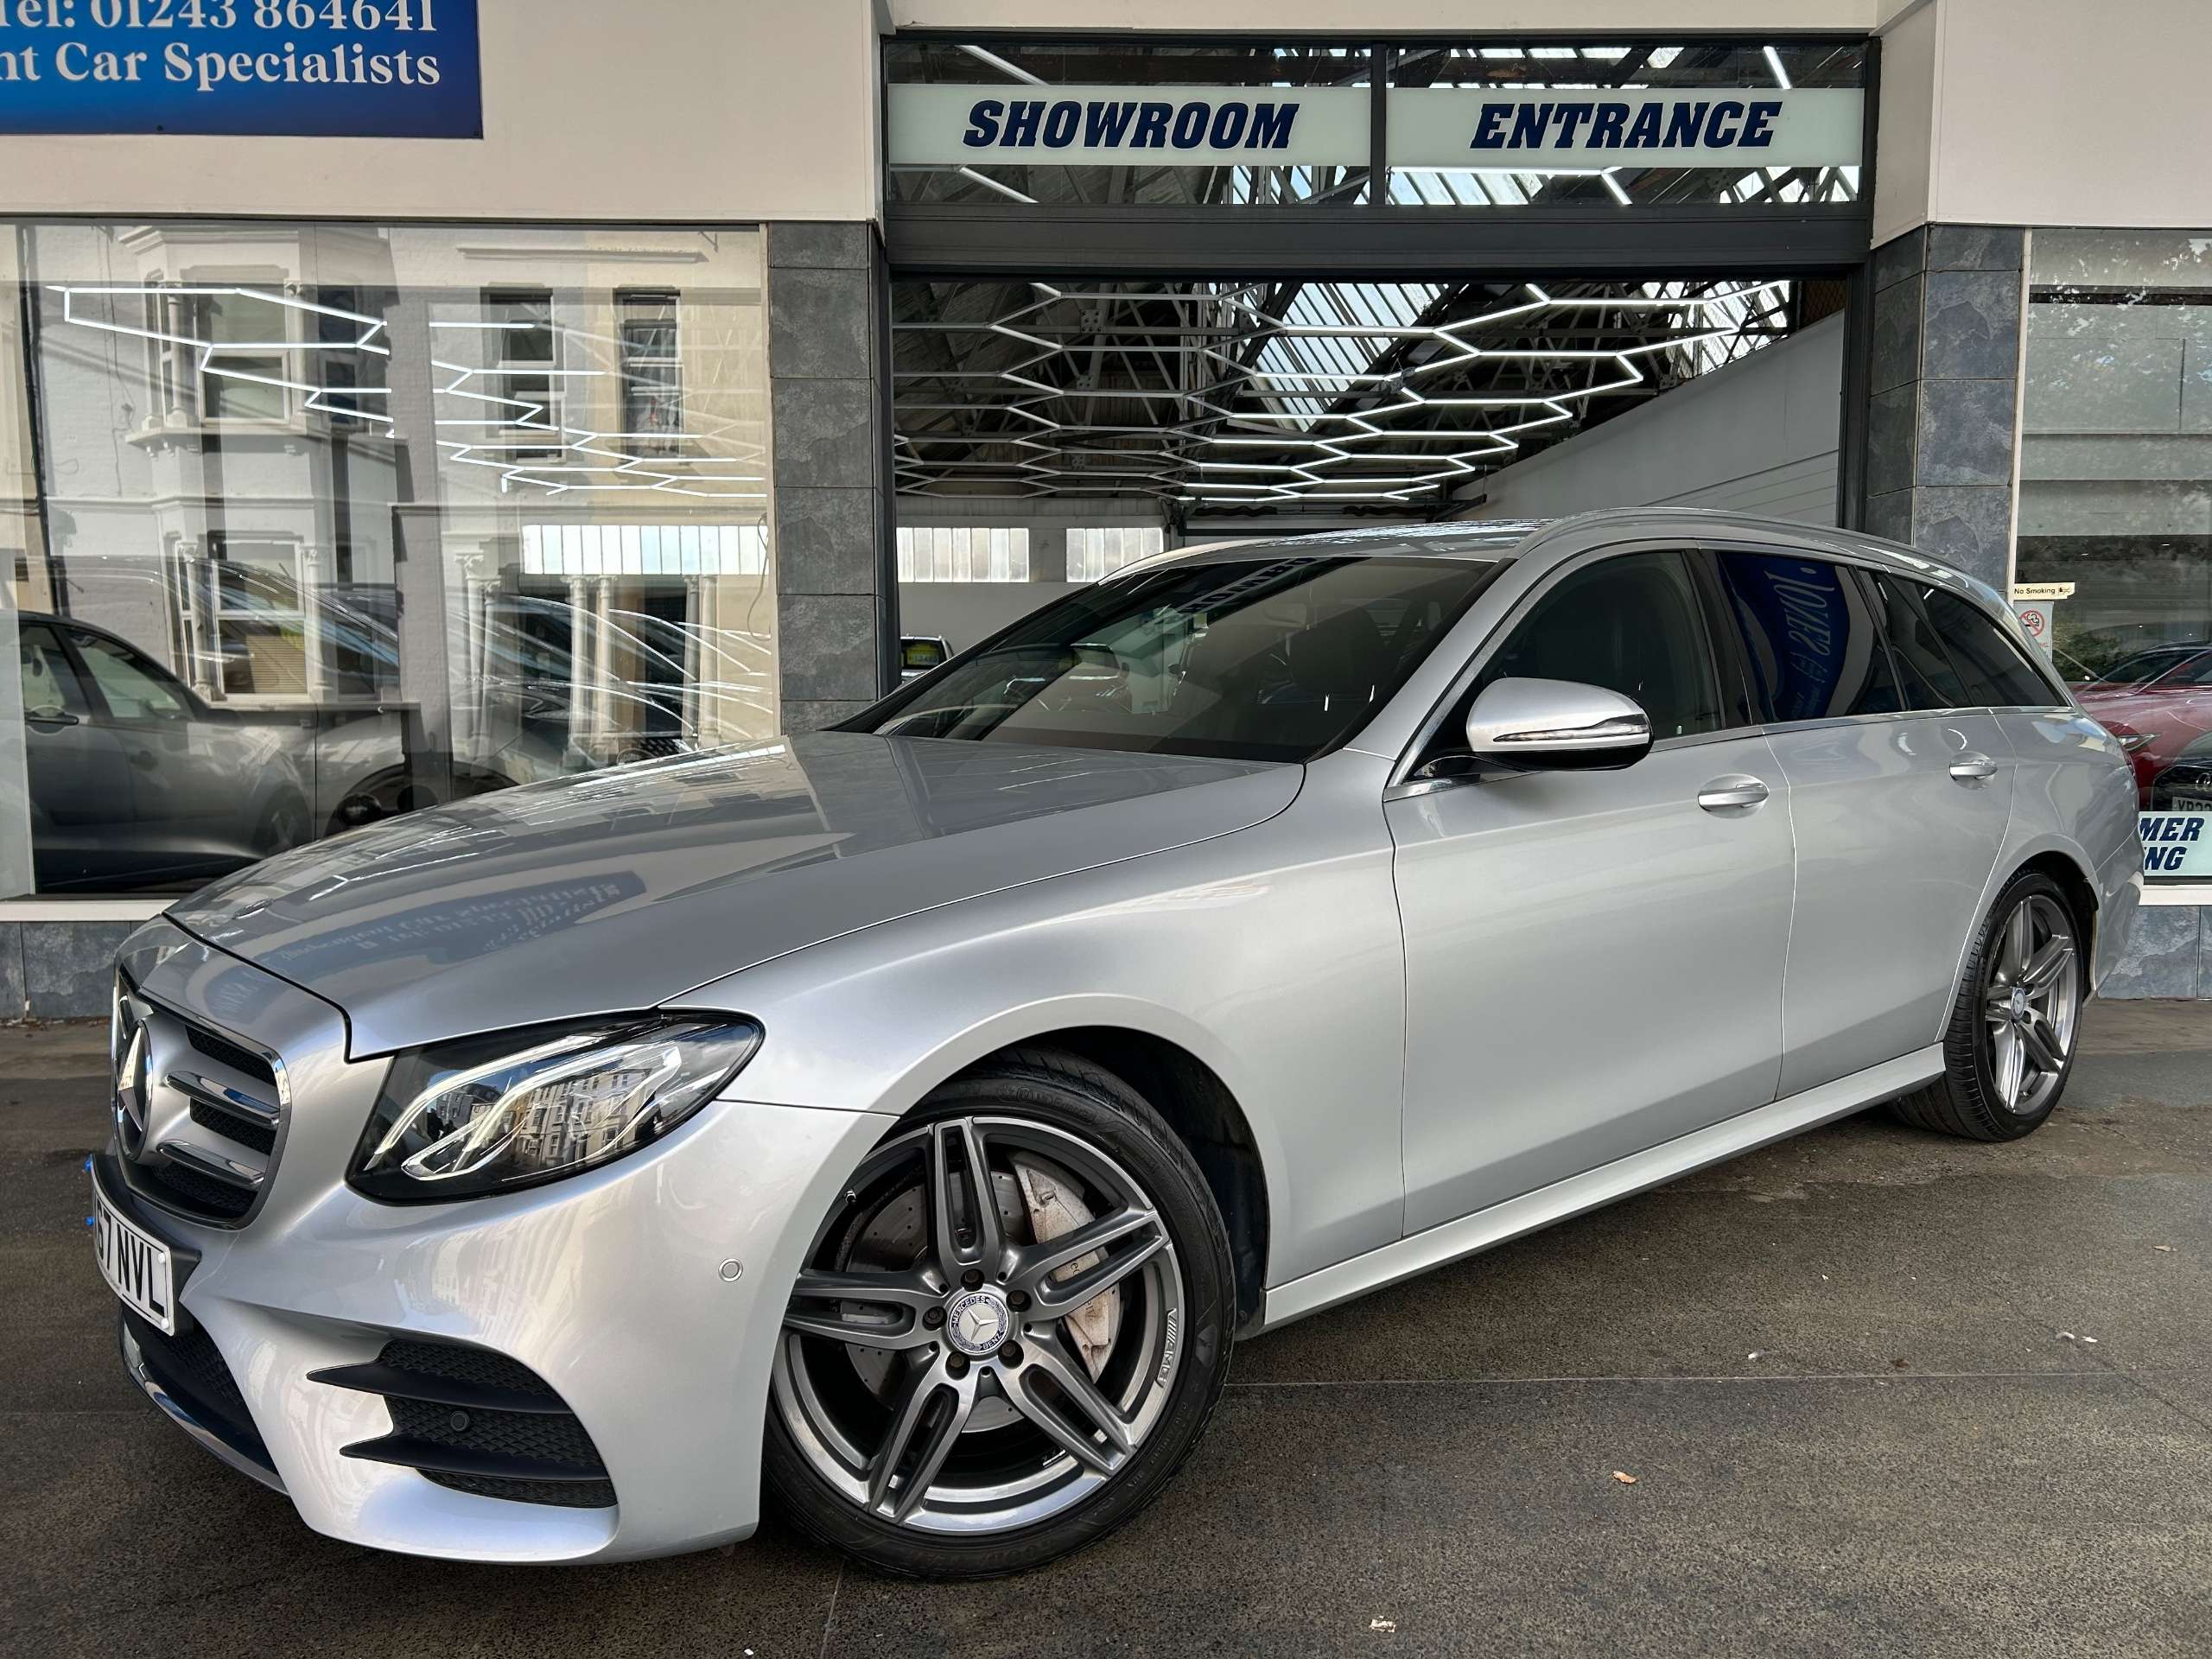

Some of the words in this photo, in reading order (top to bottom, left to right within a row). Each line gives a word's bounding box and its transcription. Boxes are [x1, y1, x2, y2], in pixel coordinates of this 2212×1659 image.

[91, 0, 236, 29] 01243
[254, 0, 437, 31] 864641
[55, 41, 148, 81] Car
[163, 41, 441, 91] Specialists
[963, 99, 1300, 149] SHOWROOM
[1470, 100, 1783, 149] ENTRANCE
[117, 1223, 165, 1318] NVL
[951, 1296, 986, 1324] MERCEDES
